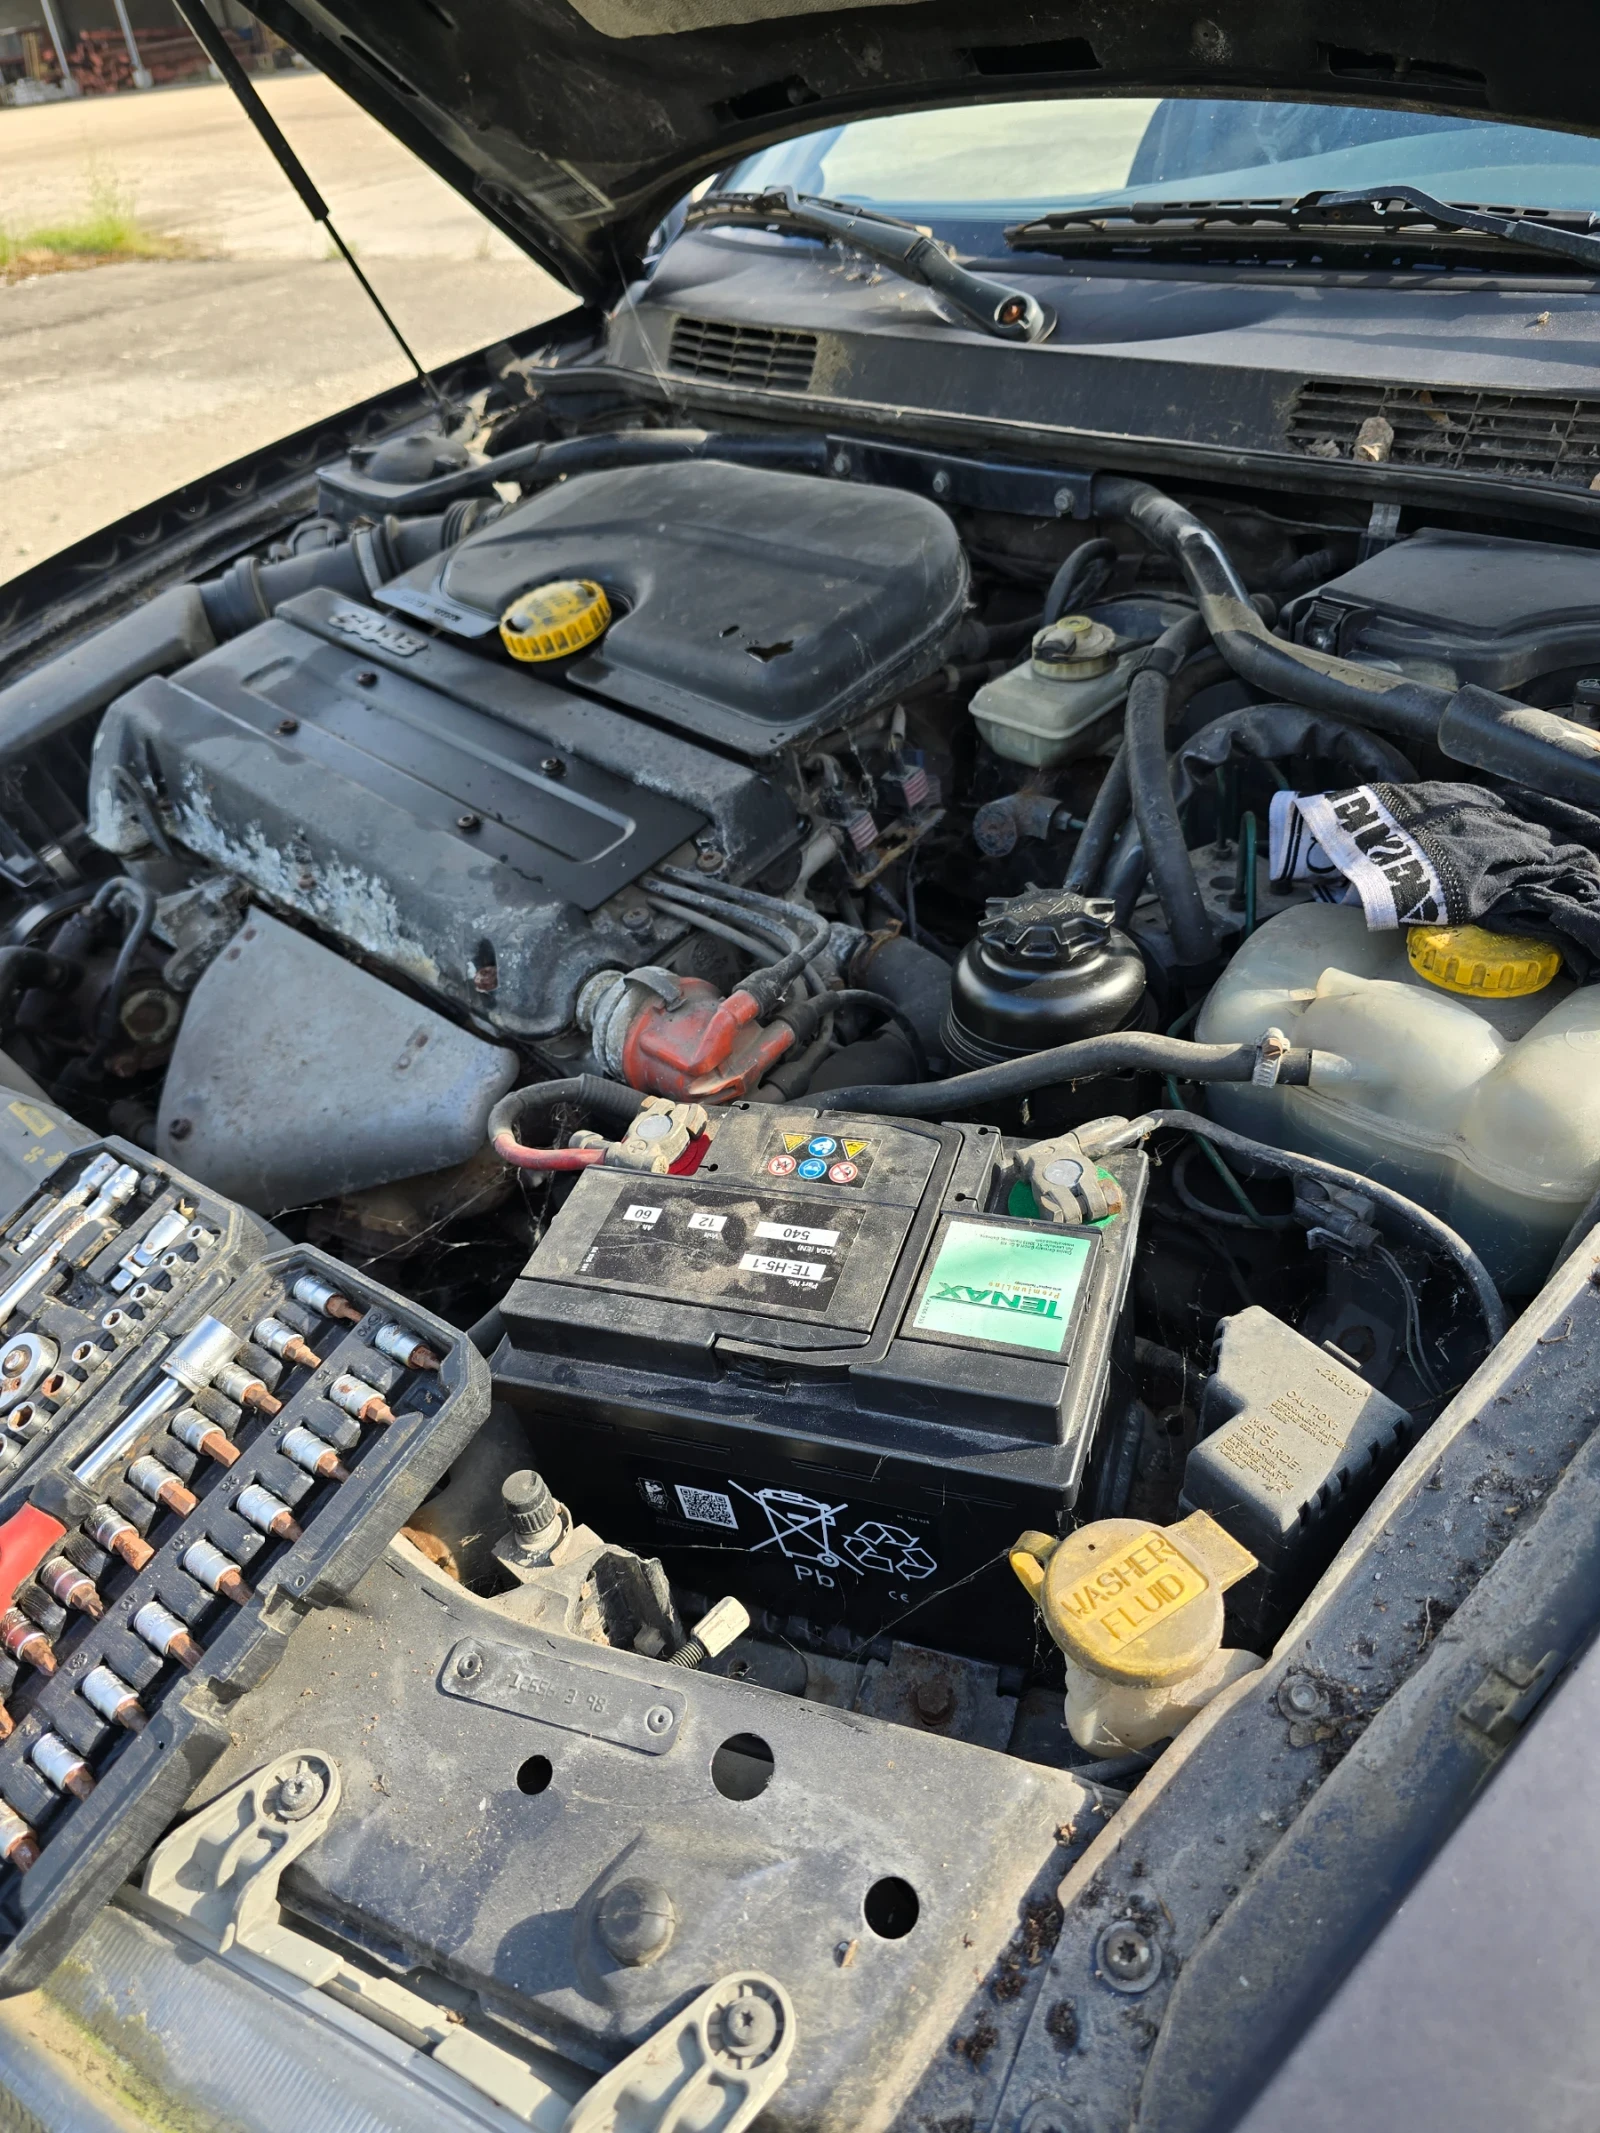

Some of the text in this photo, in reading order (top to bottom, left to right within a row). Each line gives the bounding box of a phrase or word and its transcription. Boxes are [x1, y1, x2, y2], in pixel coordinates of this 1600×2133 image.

[328, 613, 429, 657] SAAB
[634, 1208, 653, 1219] 60
[698, 1216, 715, 1228] 12
[703, 1231, 720, 1240] Volt
[783, 1227, 811, 1241] 540
[752, 1258, 811, 1277] TE-H5-1
[787, 1278, 819, 1290] Part No.
[988, 1281, 1062, 1299] PremiumLine
[929, 1282, 1063, 1320] TENAX
[1286, 1388, 1339, 1431] CAUTION:
[1249, 1415, 1280, 1440] MISE
[1239, 1423, 1303, 1474] EN GARDE:
[794, 1564, 836, 1588] Pb
[1060, 1538, 1178, 1619] WASHER
[1100, 1574, 1185, 1640] FLUID
